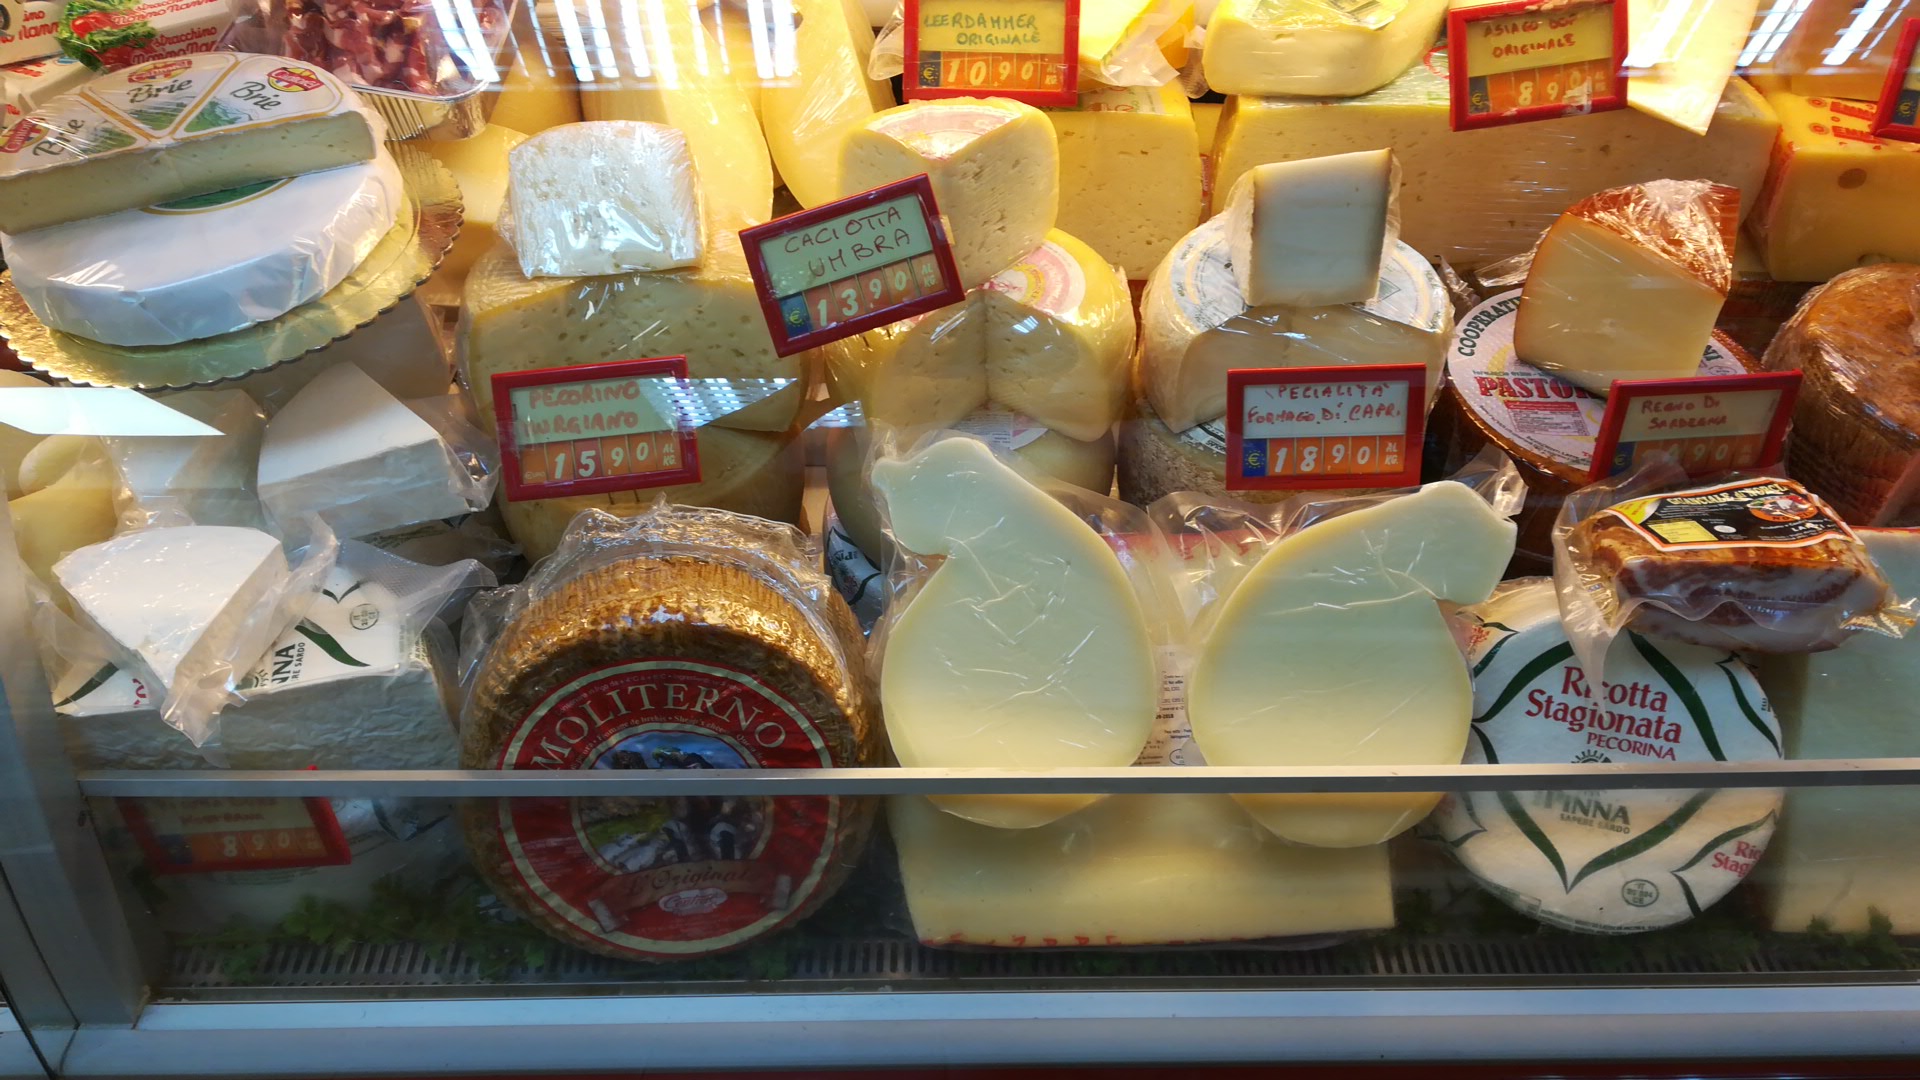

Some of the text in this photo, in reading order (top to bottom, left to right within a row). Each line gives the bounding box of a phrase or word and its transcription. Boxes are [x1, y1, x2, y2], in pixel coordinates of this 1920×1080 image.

[1484, 20, 1539, 38] ASIAGO
[127, 79, 193, 103] Brie
[230, 81, 281, 111] Brie
[784, 206, 902, 254] CACIOTTA
[1561, 666, 1668, 713] Riotta
[532, 684, 786, 769] MOLITERNO
[1525, 688, 1682, 744] Stagionata
[1587, 731, 1676, 762] PECORINA
